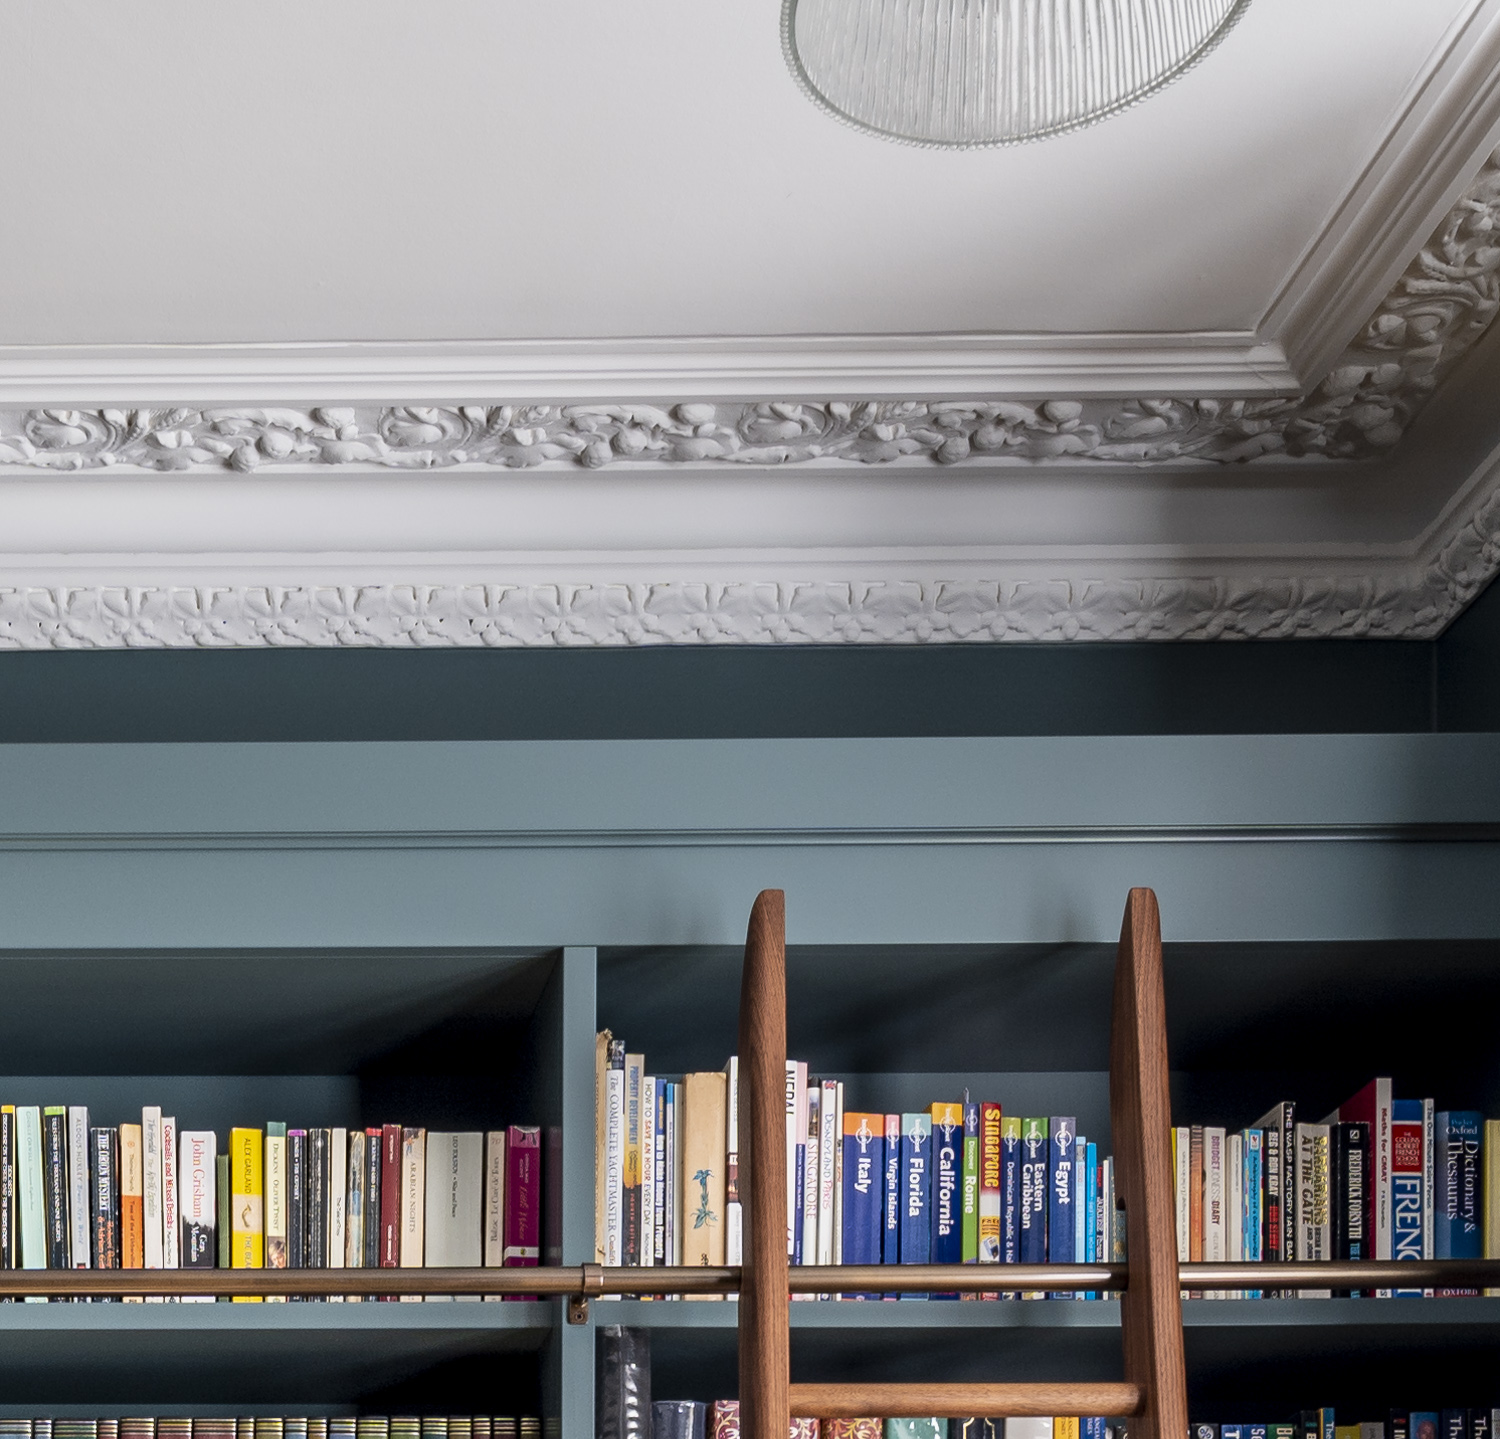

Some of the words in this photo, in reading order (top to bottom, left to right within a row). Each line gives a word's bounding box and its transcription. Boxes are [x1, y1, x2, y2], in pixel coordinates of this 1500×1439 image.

[192, 1138, 204, 1166] John
[887, 1158, 897, 1189] Virgin
[192, 1169, 204, 1217] Grisham
[856, 1158, 871, 1192] Italy
[909, 1158, 923, 1216] Florida
[939, 1147, 954, 1235] California
[965, 1176, 975, 1213] Rome
[1023, 1164, 1033, 1228] Caribbean
[1034, 1163, 1045, 1211] Eastern
[1056, 1161, 1070, 1204] Egypt
[1446, 1138, 1463, 1220] Thesaurus
[1462, 1140, 1478, 1219] Dictionary
[888, 1192, 897, 1229] Islands
[1465, 1223, 1476, 1233] &
